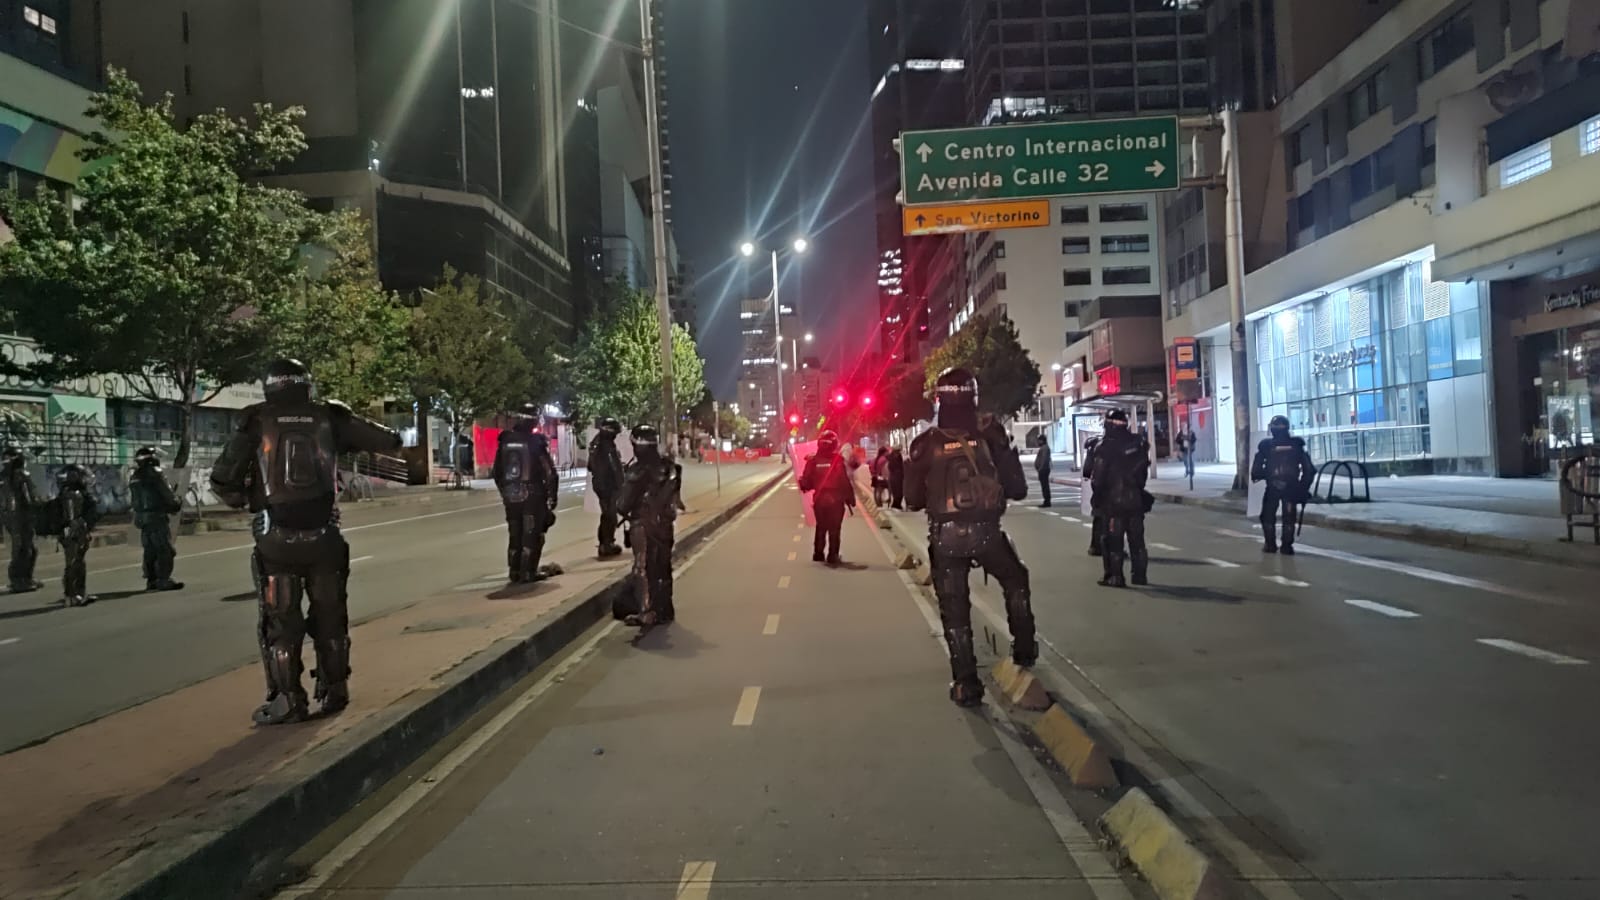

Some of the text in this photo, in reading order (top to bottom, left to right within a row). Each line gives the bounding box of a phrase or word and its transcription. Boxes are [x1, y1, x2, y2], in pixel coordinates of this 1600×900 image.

[944, 132, 1167, 161] Centro Internacional
[917, 163, 1110, 192] Avenida Calle 32
[935, 210, 1040, 226] San Victorino
